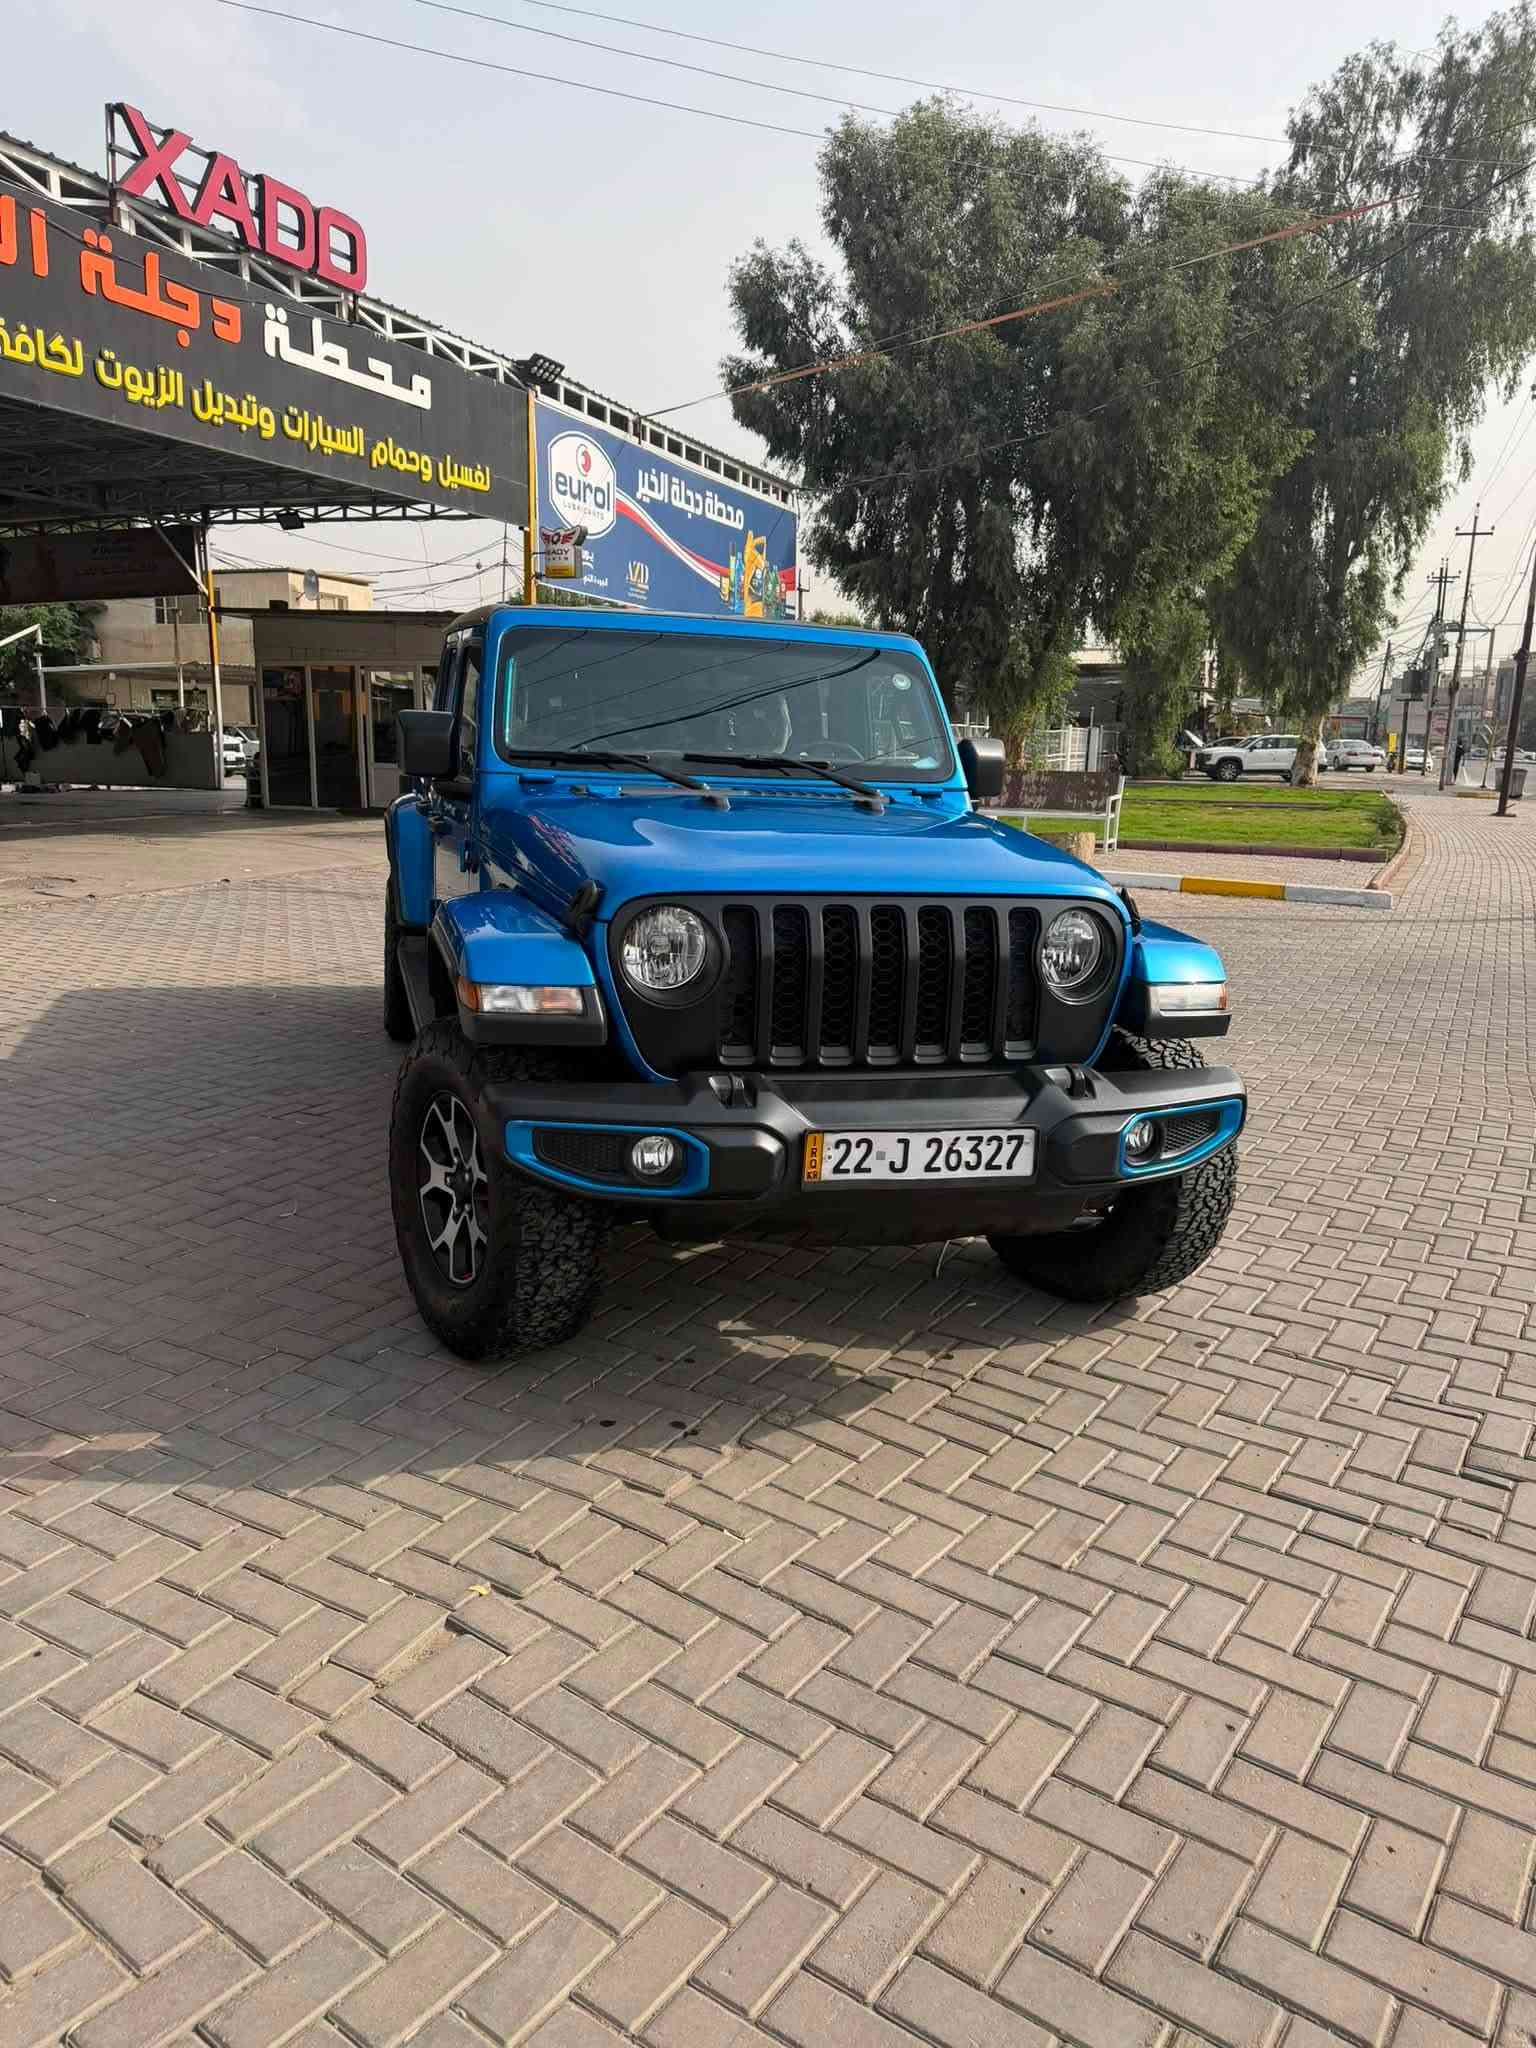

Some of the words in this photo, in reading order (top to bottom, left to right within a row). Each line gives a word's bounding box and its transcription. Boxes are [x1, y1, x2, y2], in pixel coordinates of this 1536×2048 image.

[117, 102, 367, 292] XADO
[80, 228, 241, 348] دجلة
[96, 350, 183, 408] الزيوت
[264, 303, 432, 410] محطة
[191, 380, 275, 439] وتبديل
[283, 405, 364, 456] السيارات
[371, 437, 432, 482] وحمام
[555, 471, 610, 512] eurol
[636, 468, 668, 504] الخير
[671, 476, 703, 519] دجلة
[705, 490, 744, 530] محطة
[832, 1138, 873, 1174] 22
[889, 1138, 910, 1173] J
[923, 1135, 1024, 1172] 26327
